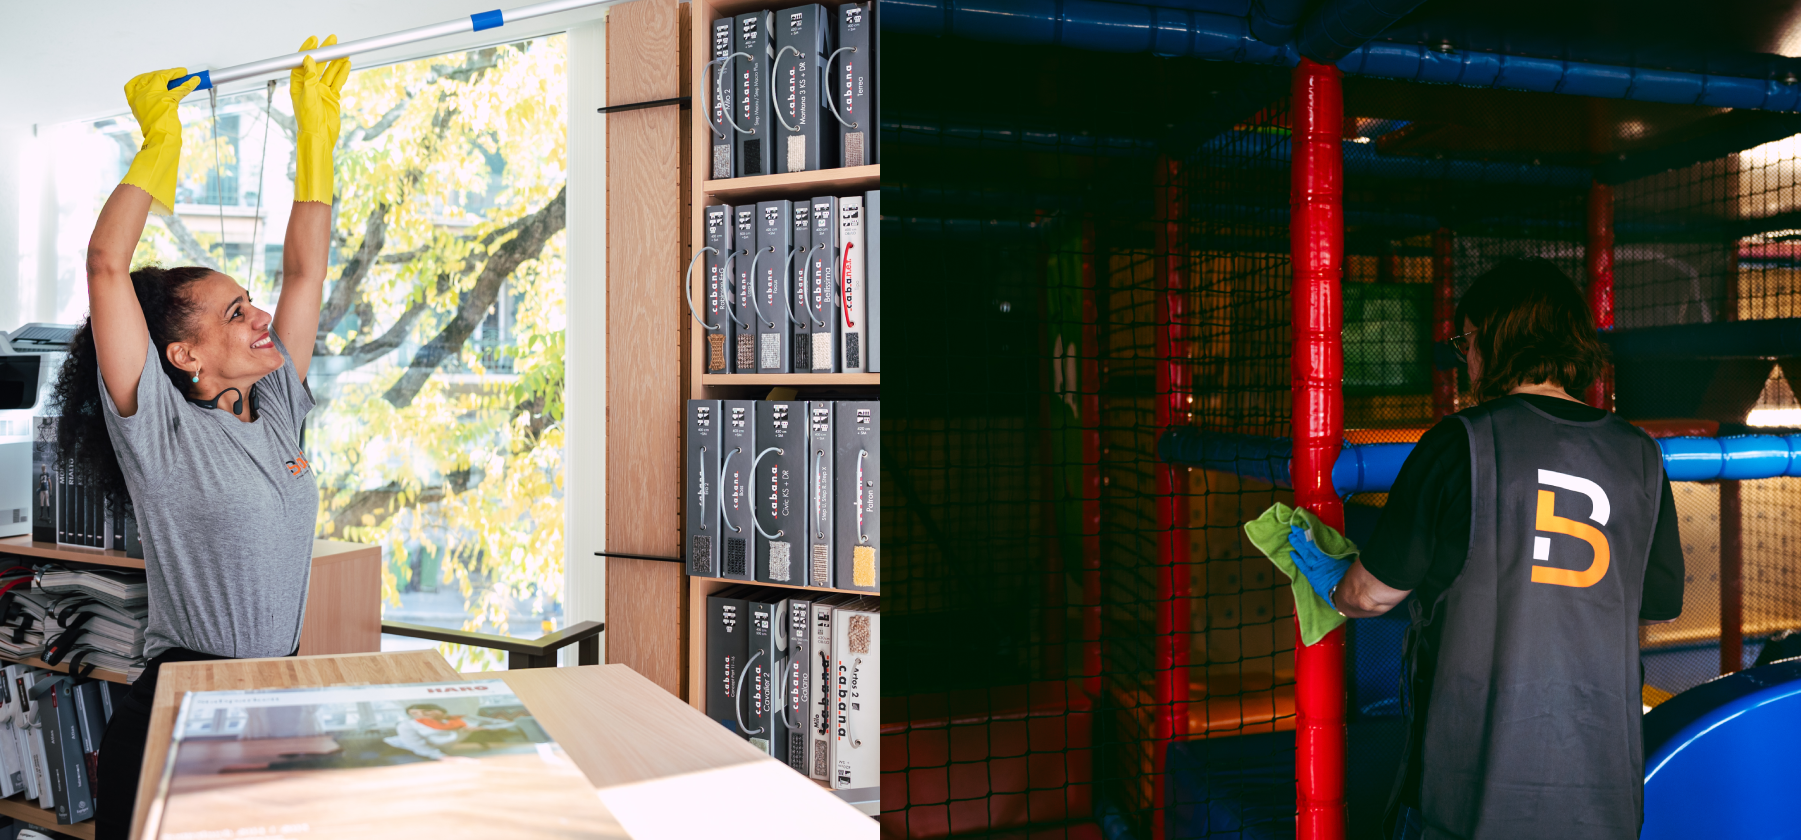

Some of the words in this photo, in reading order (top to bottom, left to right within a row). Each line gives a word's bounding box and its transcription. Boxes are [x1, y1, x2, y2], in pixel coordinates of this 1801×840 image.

[798, 62, 805, 72] DR
[799, 79, 806, 89] KS
[844, 62, 852, 113] cabana
[742, 70, 750, 118] cabana
[788, 68, 796, 116] cabana
[710, 265, 718, 314] cabana
[813, 260, 822, 311] cabana
[823, 267, 831, 303] Bellissima
[769, 465, 778, 518] cabana
[782, 470, 789, 480] DR
[782, 488, 789, 498] KS
[866, 490, 874, 512] Patron
[1531, 469, 1610, 587] B
[753, 666, 761, 717] cabana
[791, 662, 799, 712] cabana
[838, 662, 848, 740] cabana
